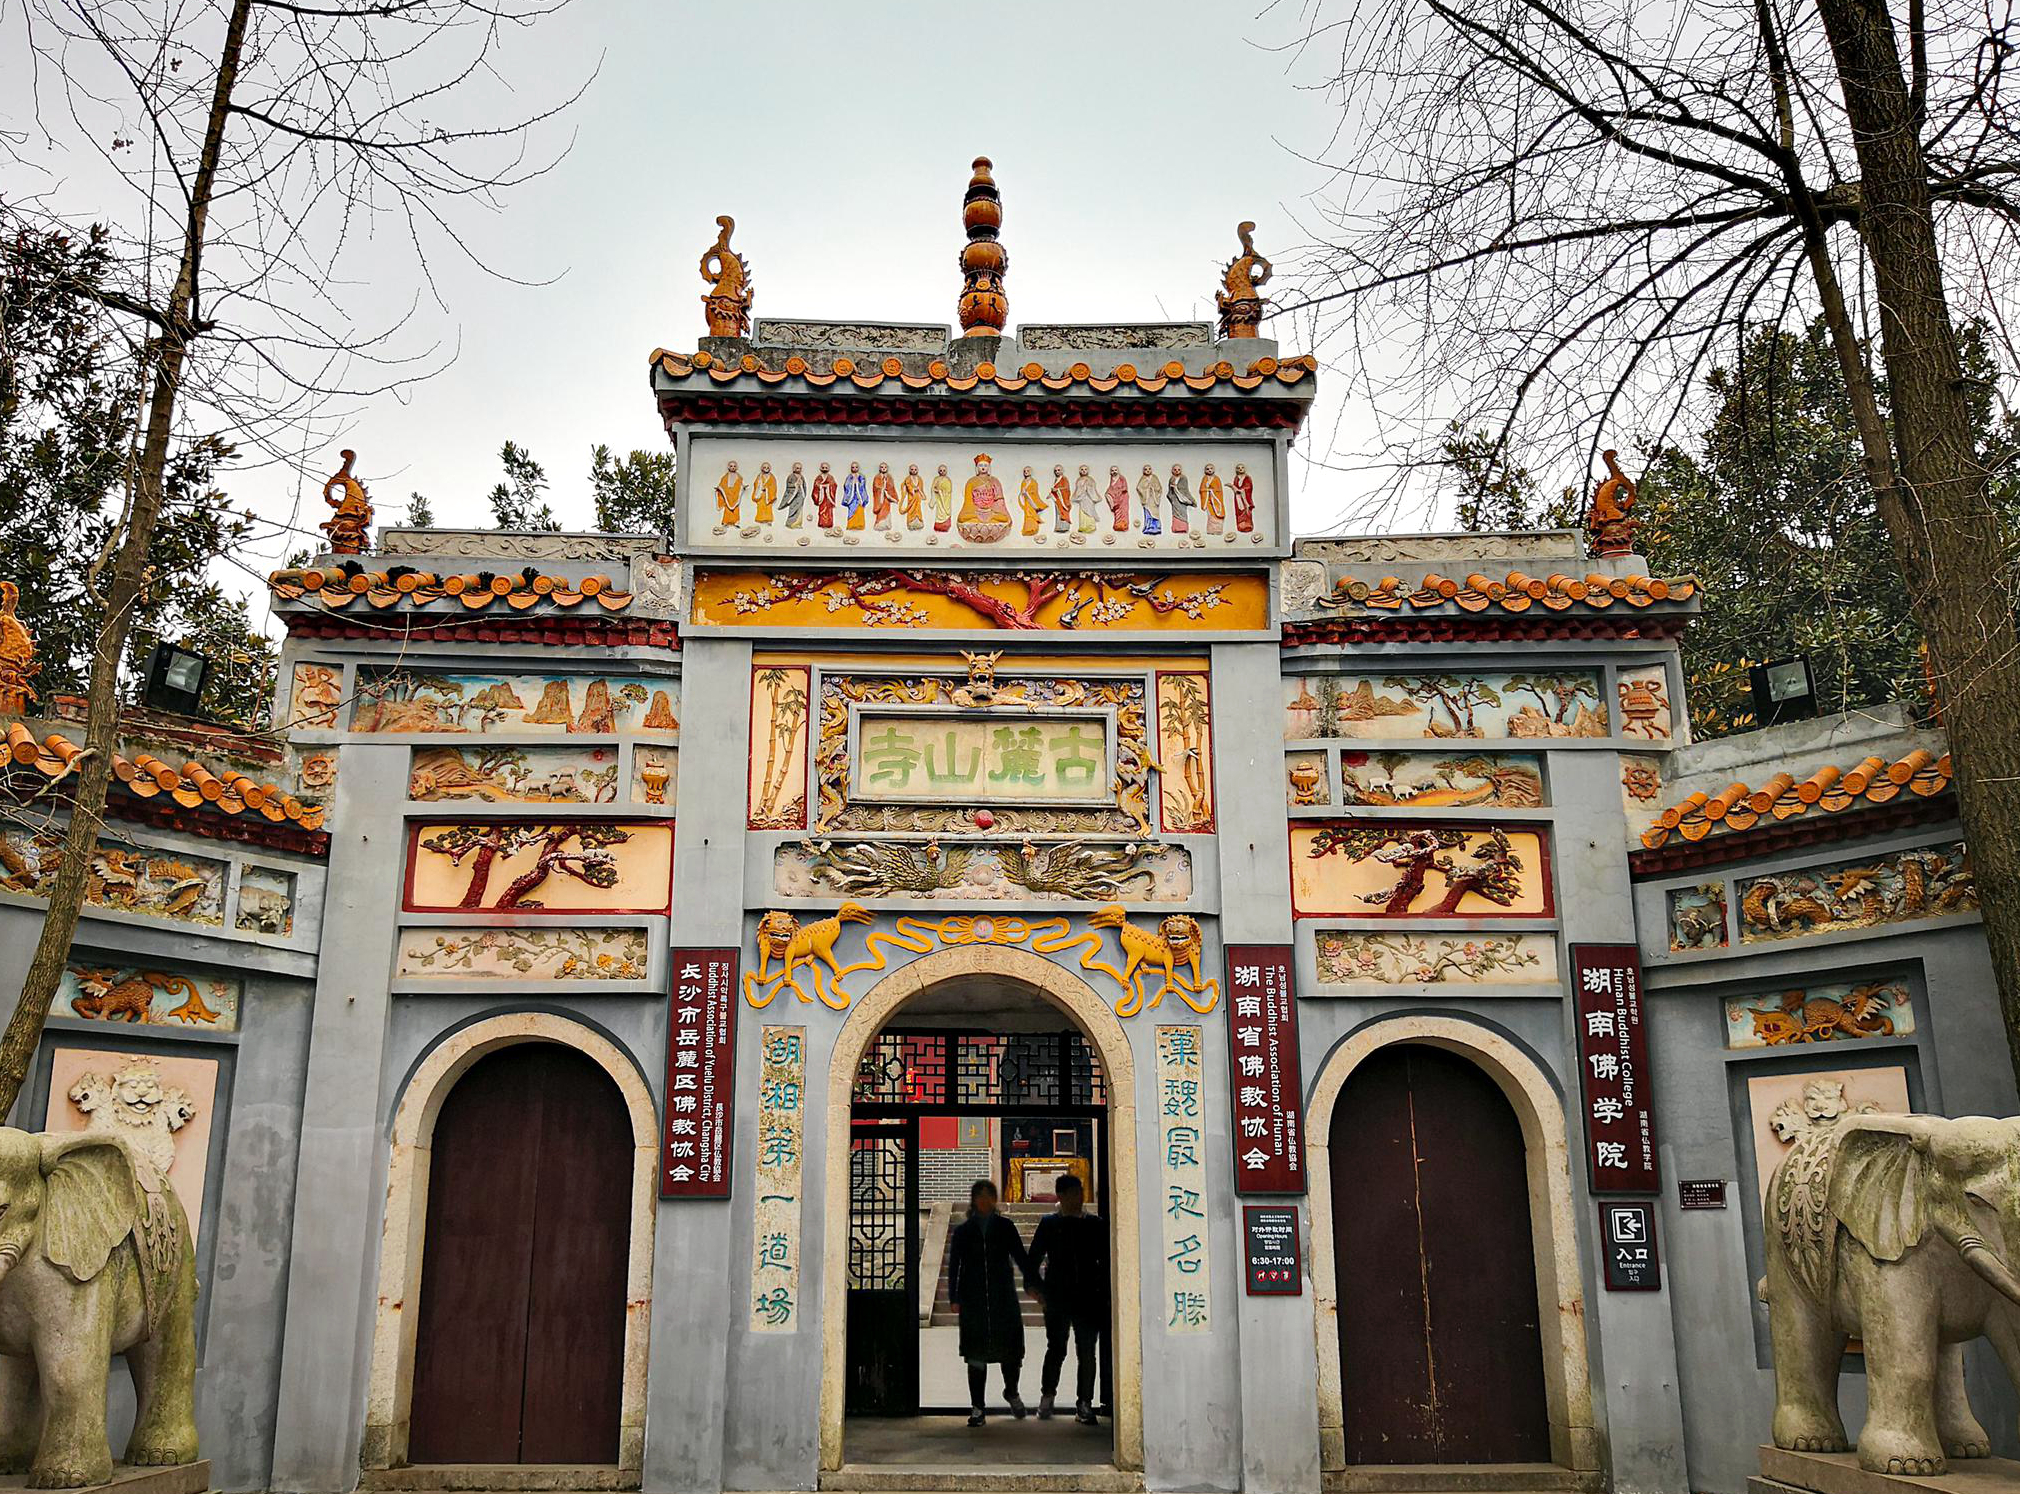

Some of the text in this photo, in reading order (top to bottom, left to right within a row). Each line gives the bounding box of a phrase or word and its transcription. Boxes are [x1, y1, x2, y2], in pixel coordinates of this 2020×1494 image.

[863, 726, 1103, 788] 古麓山寺
[669, 963, 703, 1183] 长沙市岳麓区佛教协会
[699, 962, 719, 1182] Buddhist Association of Yuelu District, Changsha City
[1234, 965, 1271, 1171] 湖南省佛教协会
[1265, 965, 1284, 1156] The Buddhist Association of Hunan
[1582, 967, 1630, 1170] 湖南佛学院
[1613, 968, 1634, 1107] Hunan Buddhist College
[1252, 1257, 1294, 1265] 6:30-17:00
[1616, 1248, 1648, 1260] 入口
